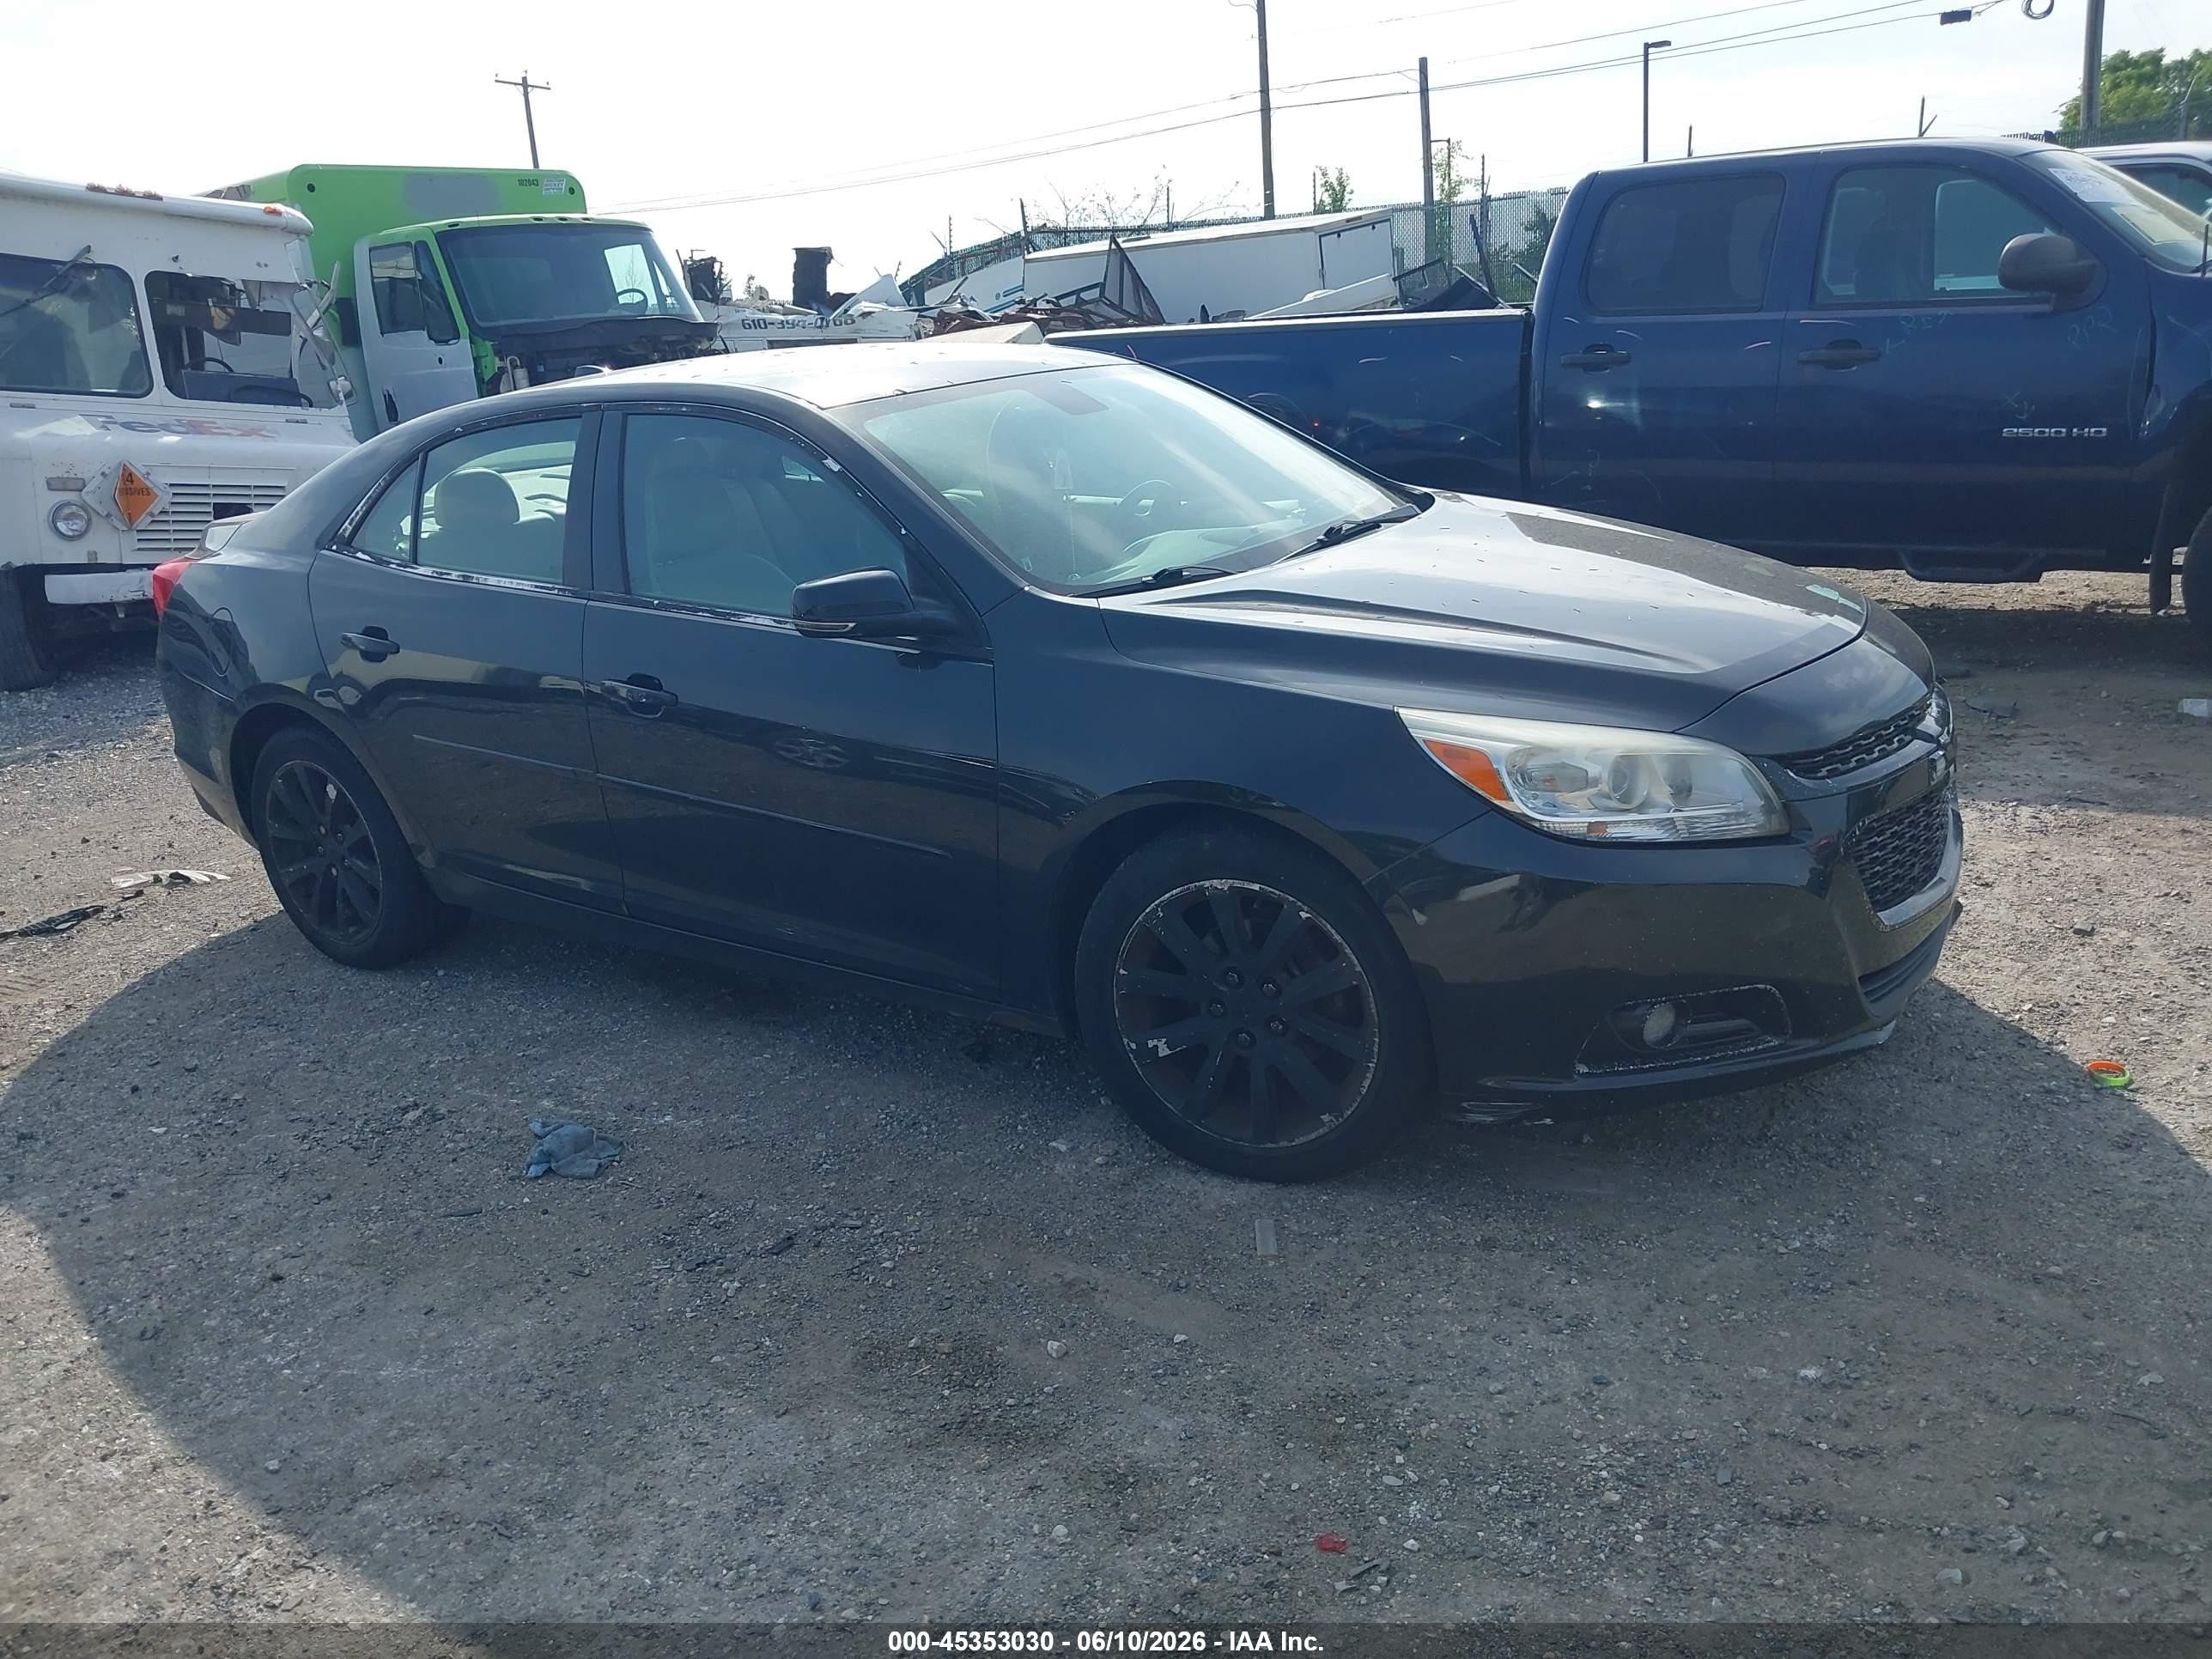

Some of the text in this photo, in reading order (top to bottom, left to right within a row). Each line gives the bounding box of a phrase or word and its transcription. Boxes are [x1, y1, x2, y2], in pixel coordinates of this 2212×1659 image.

[79, 413, 279, 440] FedEx
[2002, 428, 2107, 437] 2500 HD
